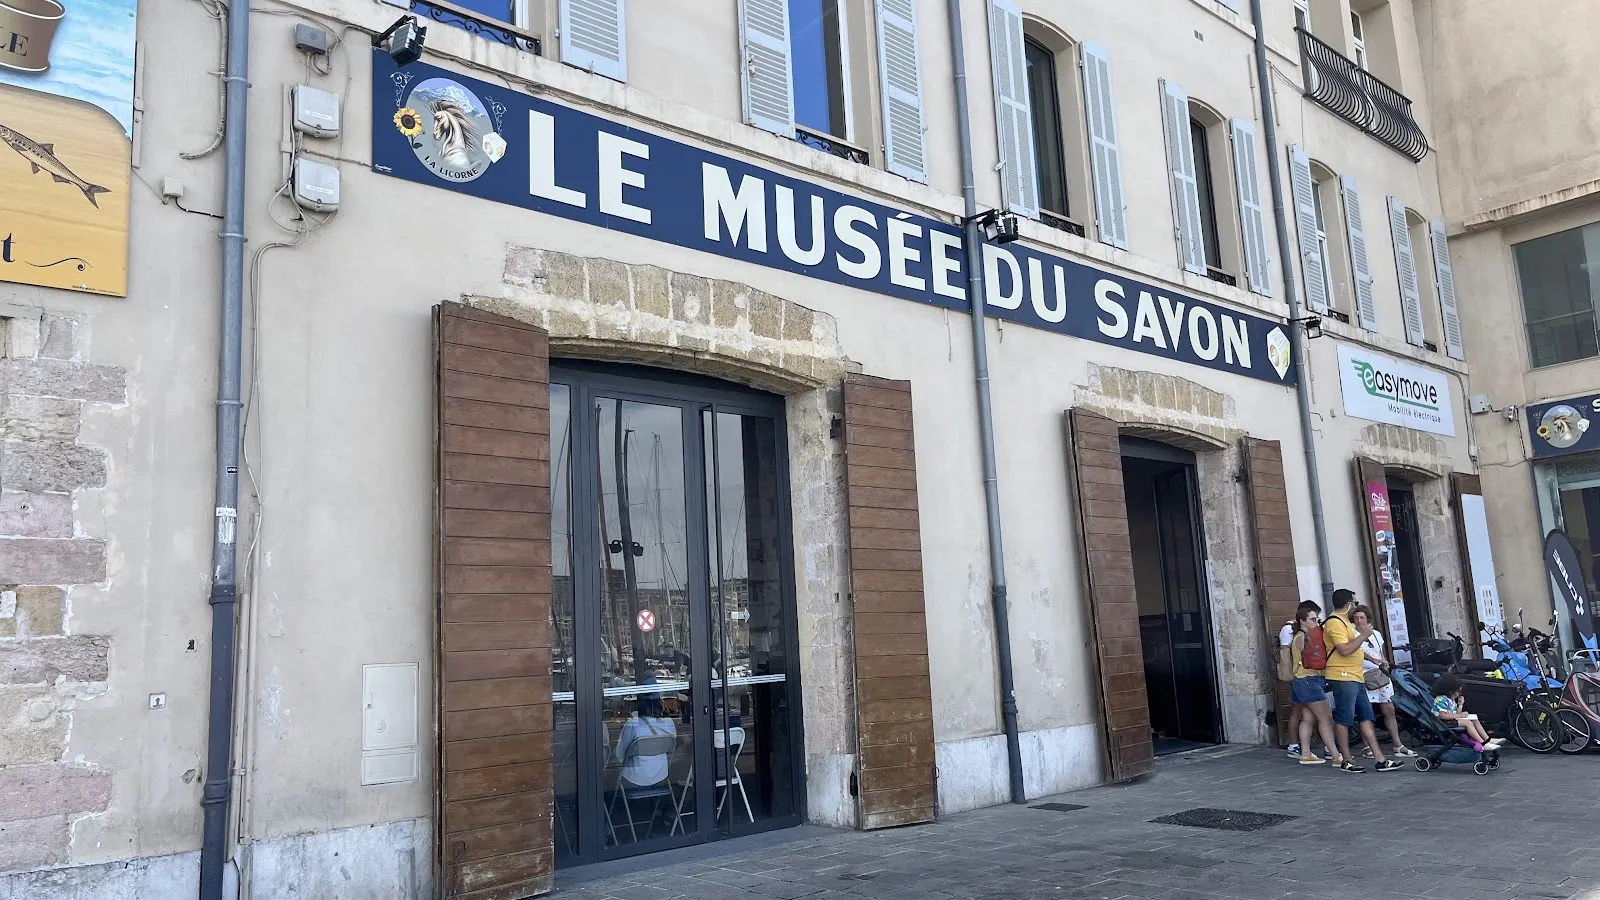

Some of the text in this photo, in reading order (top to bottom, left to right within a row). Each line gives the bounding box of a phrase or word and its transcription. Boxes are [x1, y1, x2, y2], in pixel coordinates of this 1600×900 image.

[0, 26, 29, 56] E
[424, 155, 479, 179] LA LICORNE
[529, 109, 1252, 369] LE MUSÉE DU SAVON
[1363, 367, 1438, 404] easymove
[1387, 403, 1441, 423] Mobilité électrique
